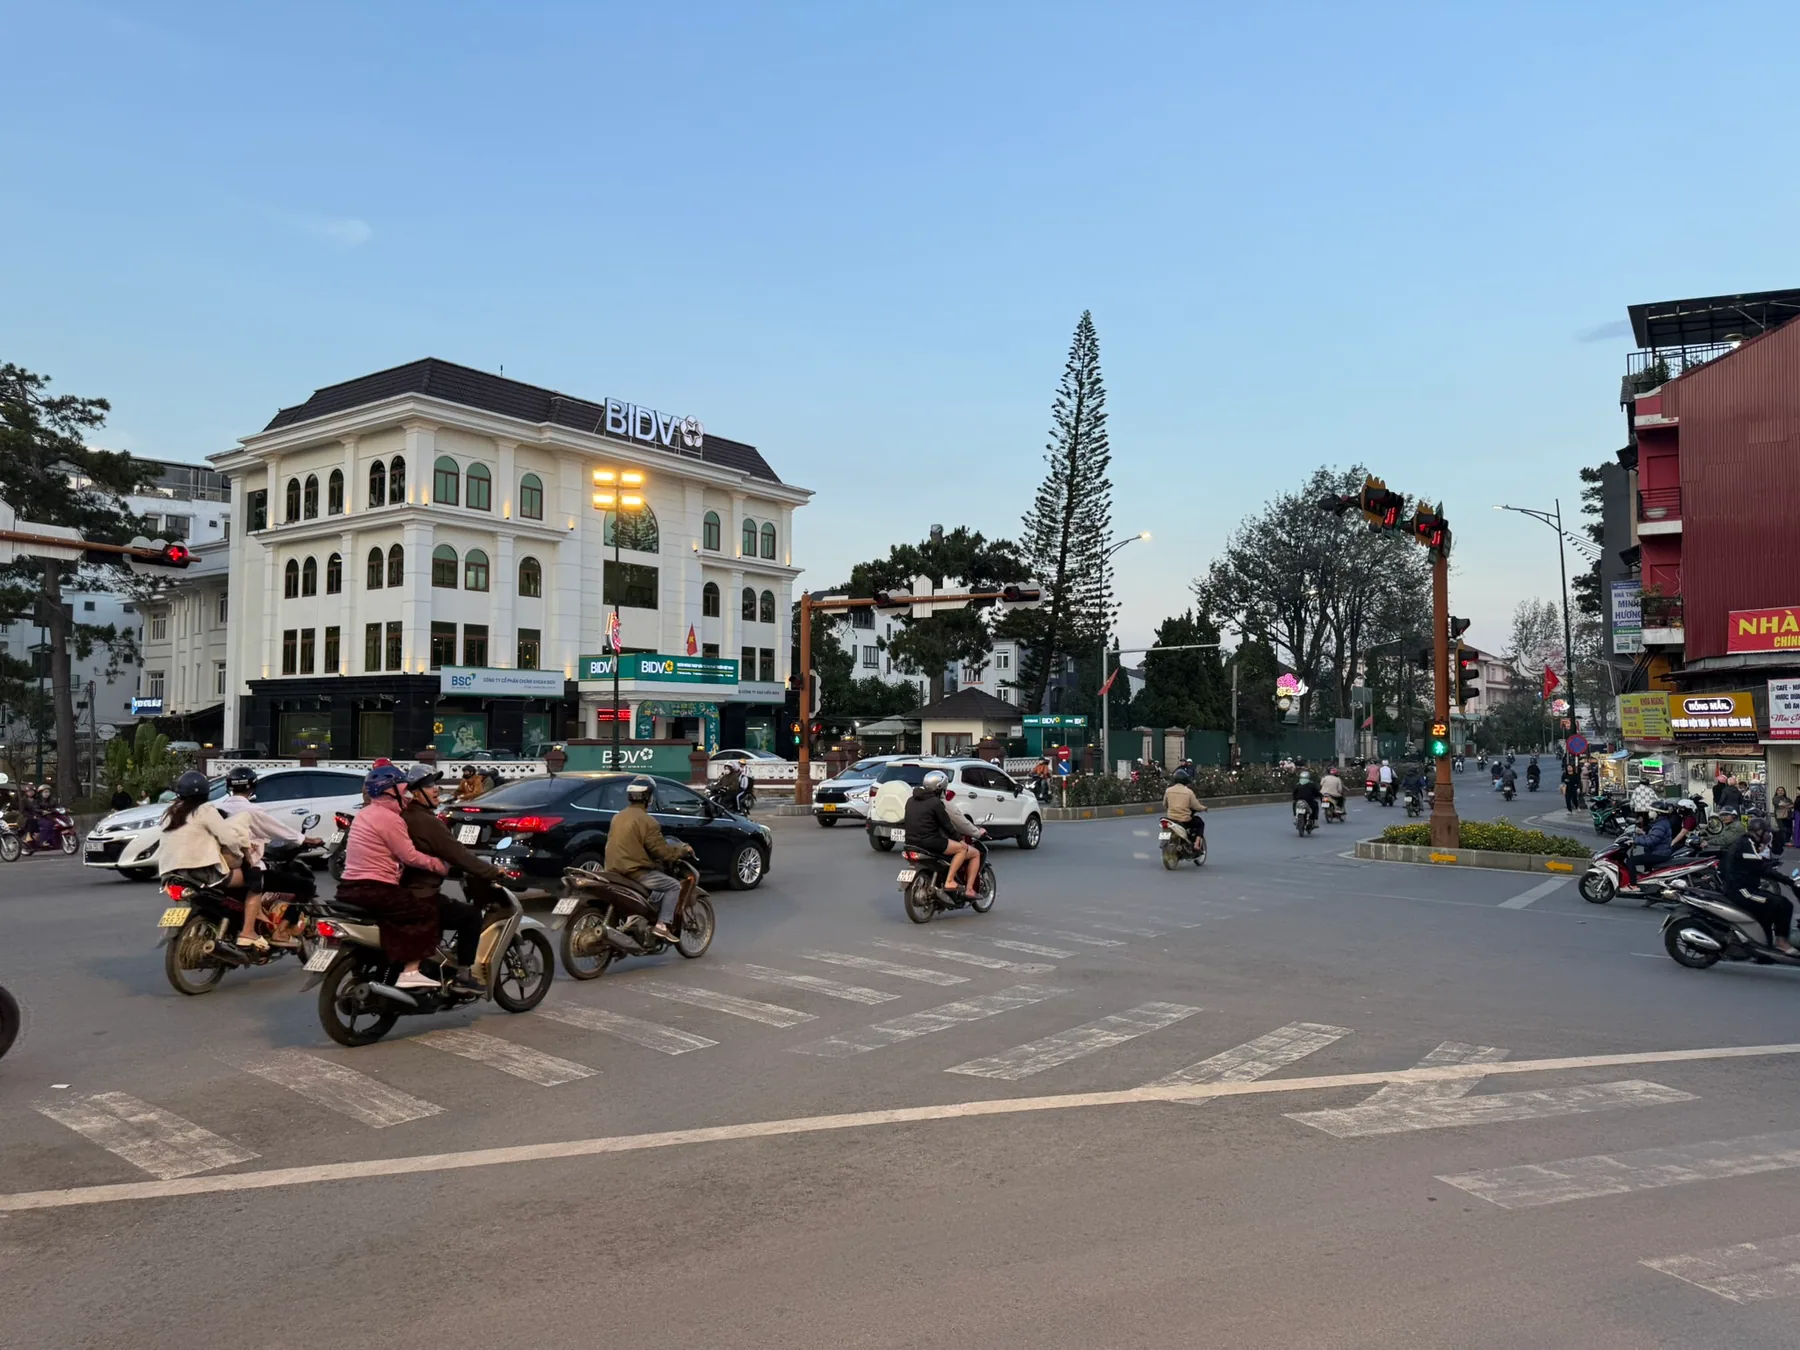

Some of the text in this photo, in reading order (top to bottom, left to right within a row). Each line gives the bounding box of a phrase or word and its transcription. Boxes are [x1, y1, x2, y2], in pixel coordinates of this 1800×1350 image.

[605, 397, 678, 446] BIDV
[1739, 610, 1800, 636] NHÀ
[591, 659, 612, 674] BIDV
[641, 660, 665, 674] BIDV
[451, 675, 472, 686] BSC
[1432, 724, 1446, 736] 22
[602, 750, 640, 764] BDV
